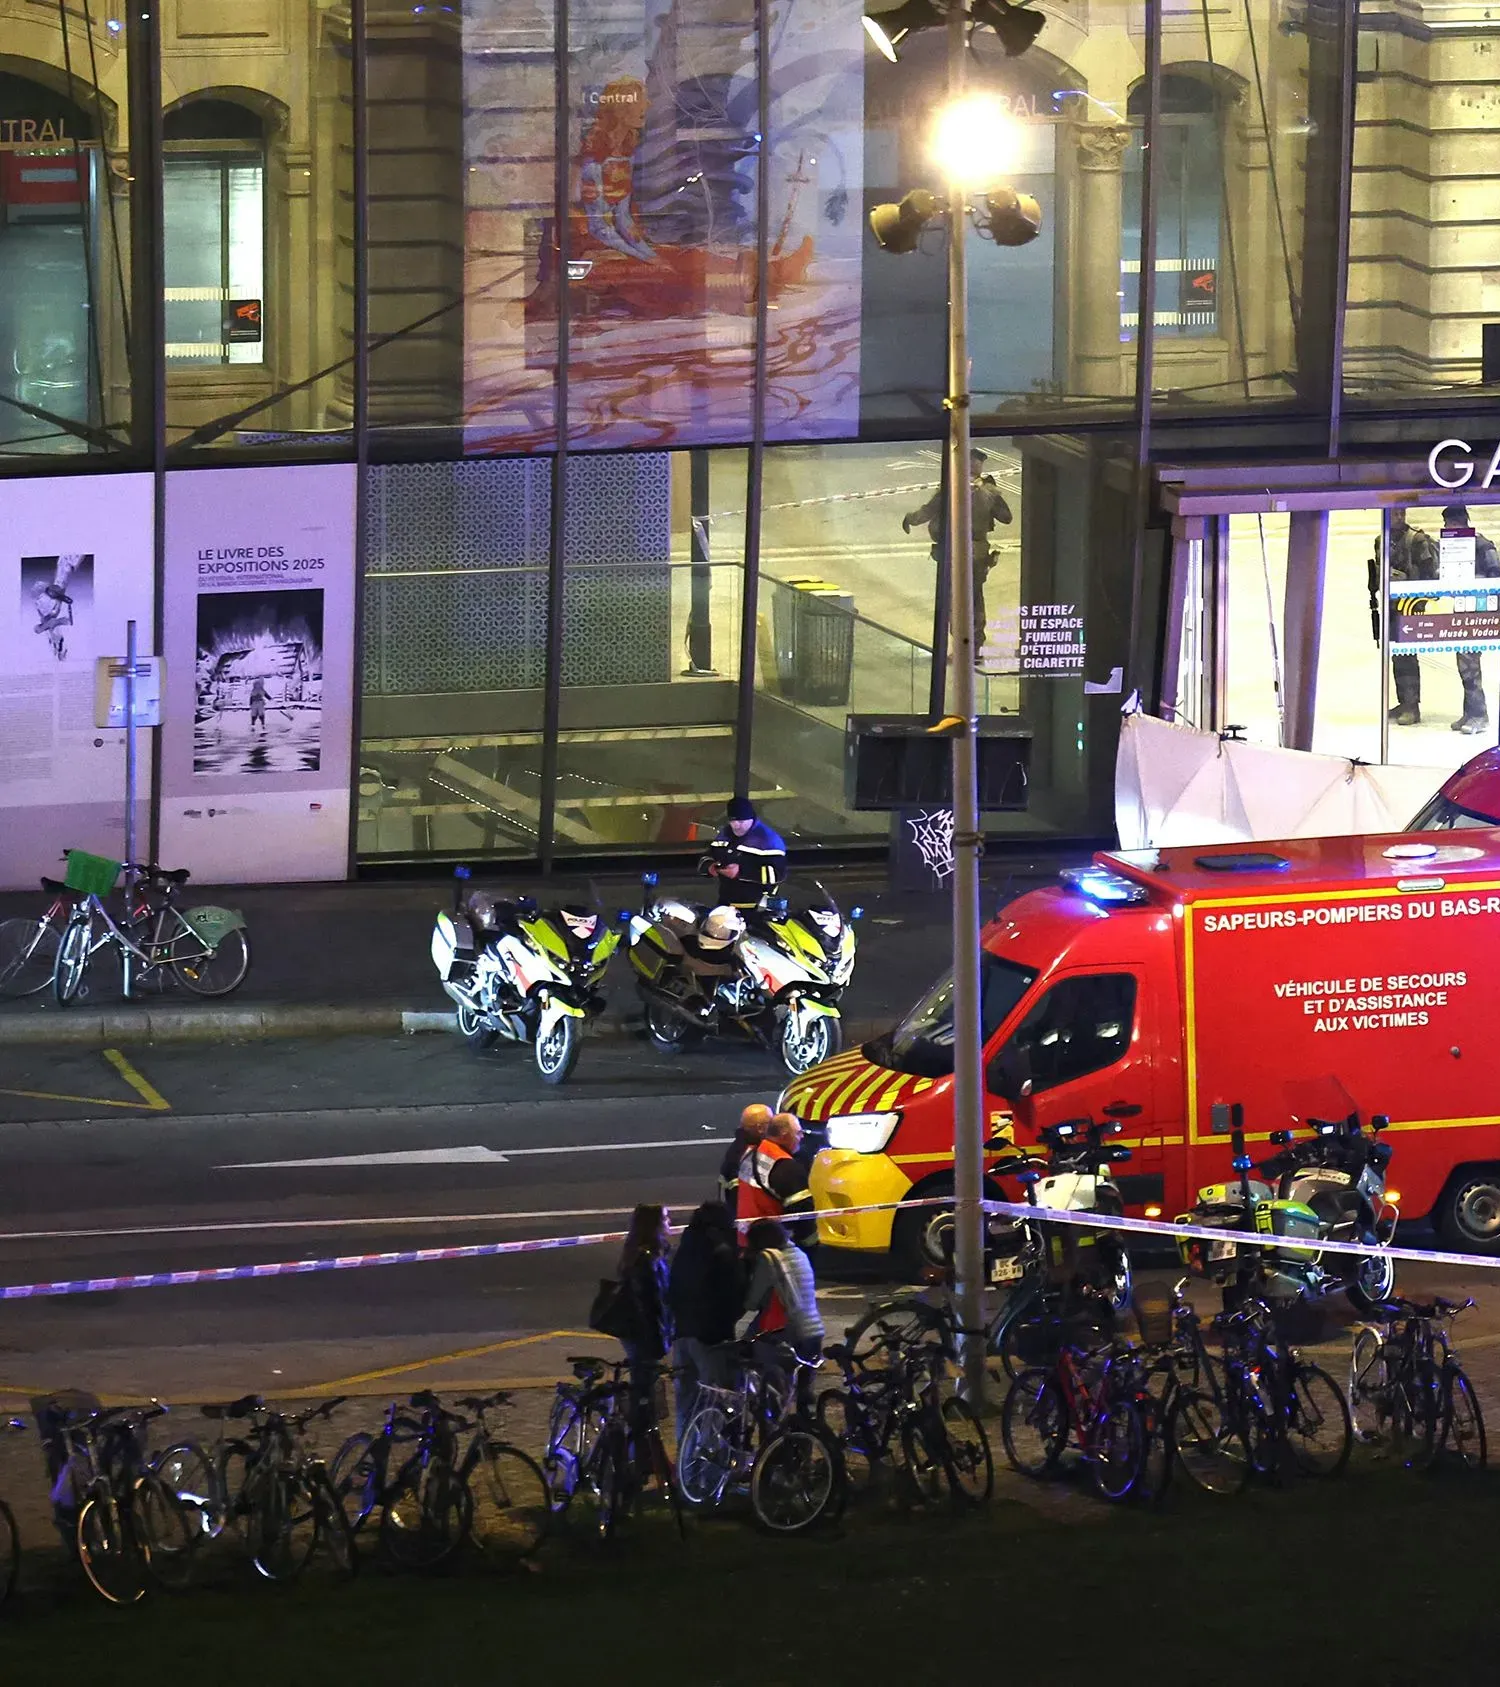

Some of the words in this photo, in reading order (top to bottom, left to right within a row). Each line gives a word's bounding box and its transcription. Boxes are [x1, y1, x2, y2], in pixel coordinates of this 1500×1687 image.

[590, 91, 638, 104] Central
[0, 118, 73, 141] TRAL
[198, 549, 213, 561] LE
[217, 547, 254, 560] LIVRE
[257, 546, 285, 558] DES
[198, 560, 290, 575] EXPOSITIONS
[293, 558, 325, 571] 2025
[1021, 619, 1037, 630] UN
[1040, 618, 1084, 629] ESPACE
[1451, 617, 1462, 627] La
[1465, 616, 1500, 626] Laiterie
[1438, 629, 1468, 638] Musée
[1472, 628, 1500, 637] Vodou
[1020, 642, 1087, 656] D'ÉTEINDRE
[1023, 657, 1085, 669] CIGARETTE
[1203, 903, 1403, 932] SAPEURS-POMPIERS
[1408, 900, 1435, 920] DU
[1274, 976, 1357, 999] VÉHICULE
[1360, 975, 1383, 992] DE
[1387, 971, 1467, 991] SECOURS
[1304, 1000, 1325, 1015] ET
[1328, 991, 1448, 1013] D'ASSISTANCE
[1314, 1016, 1349, 1033] AUX
[1352, 1011, 1429, 1030] VICTIMES
